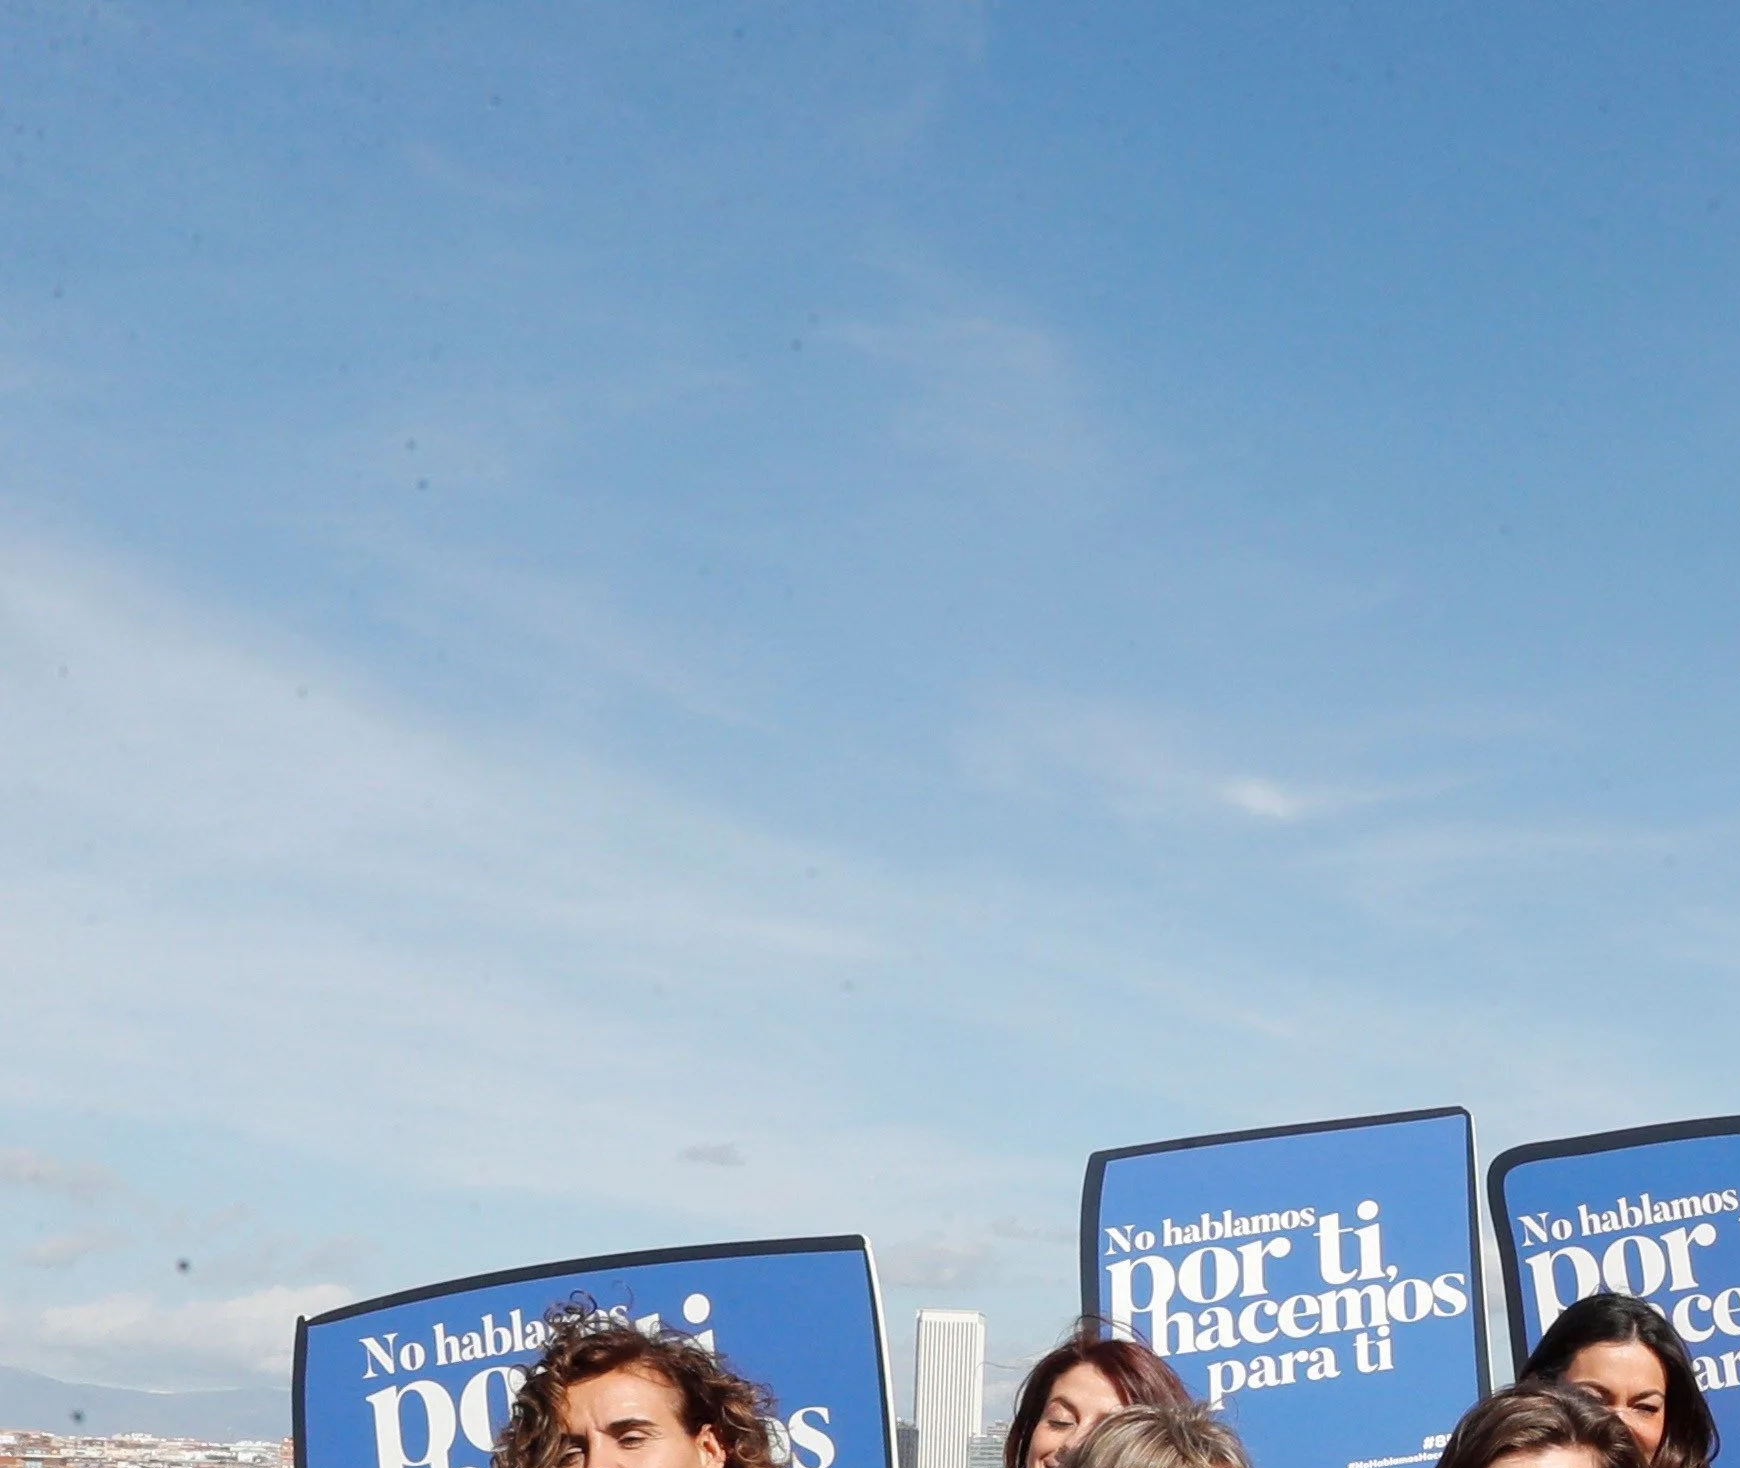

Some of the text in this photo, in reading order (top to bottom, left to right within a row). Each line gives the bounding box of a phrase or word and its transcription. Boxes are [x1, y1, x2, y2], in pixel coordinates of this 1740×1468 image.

[1105, 1206, 1316, 1256] No hablamos
[1517, 1188, 1739, 1247] No hablamos
[1106, 1199, 1398, 1343] por ti,
[1525, 1223, 1718, 1345] por
[1150, 1273, 1468, 1357] hacemos
[359, 1332, 425, 1380] No
[1206, 1324, 1394, 1411] para ti
[1423, 1433, 1452, 1450] #8
